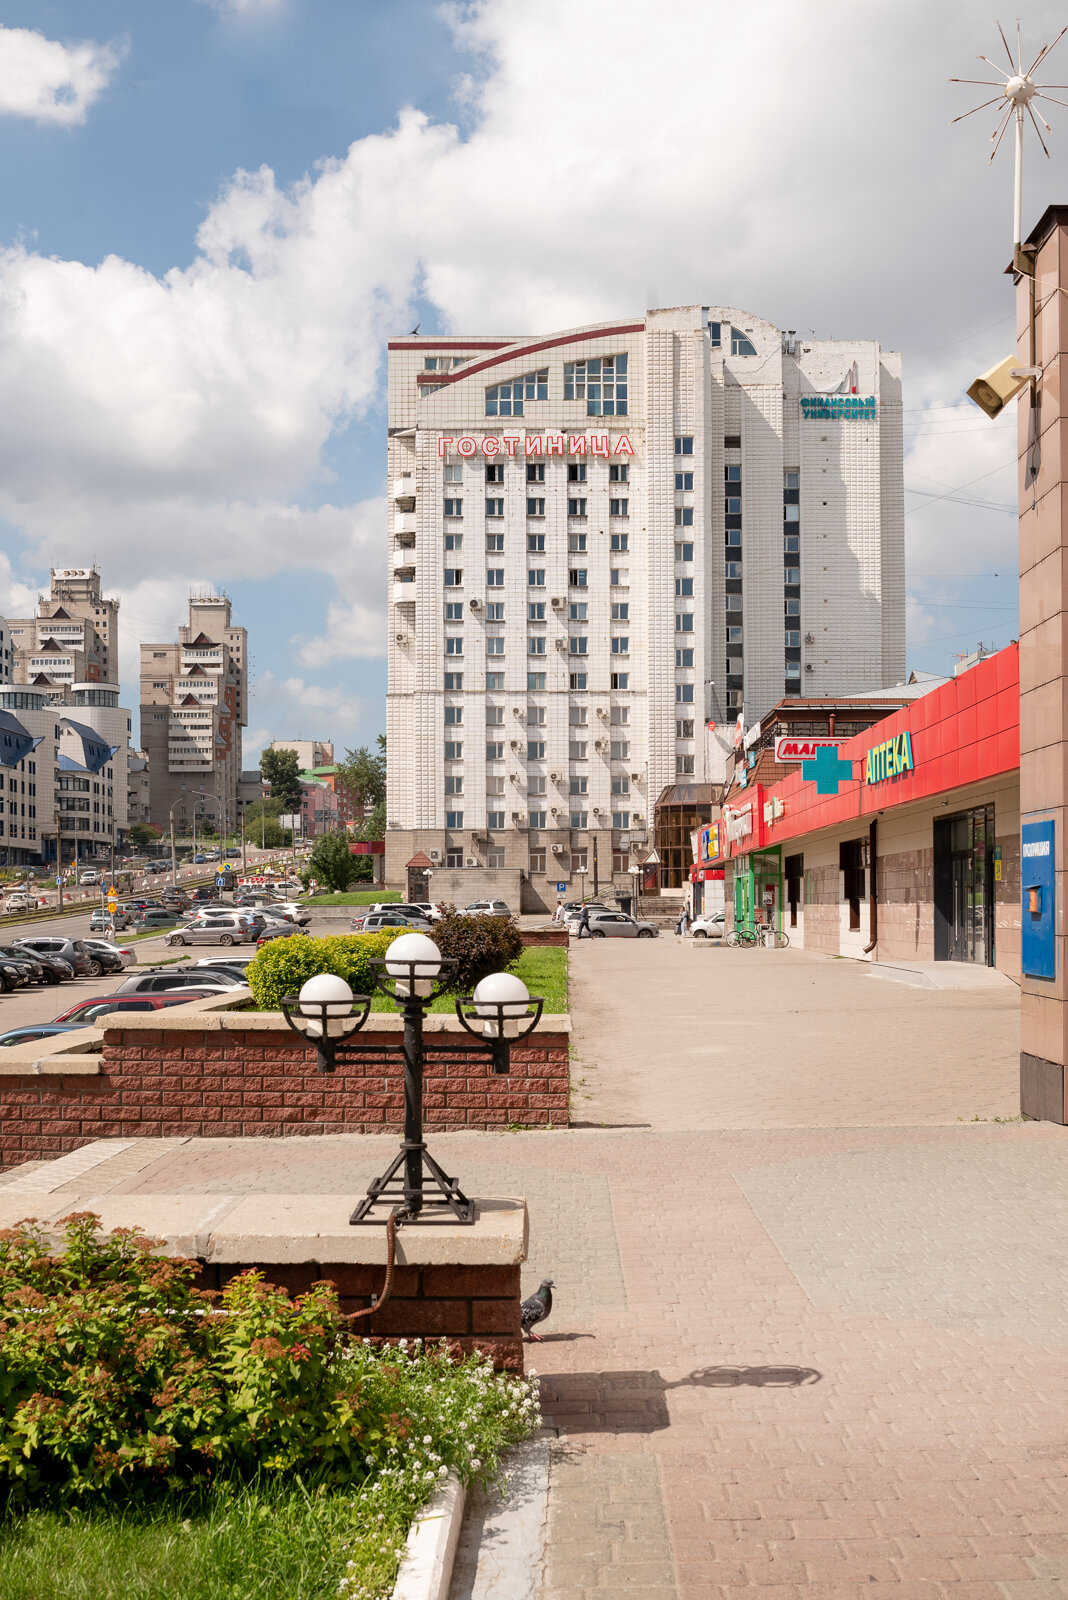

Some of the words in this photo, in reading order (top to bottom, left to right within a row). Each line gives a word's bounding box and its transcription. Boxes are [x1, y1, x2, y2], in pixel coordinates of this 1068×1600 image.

[800, 396, 876, 408] ФИНАНСОВЫЙ
[803, 409, 876, 419] УНИВЕРСИТЕТ
[438, 436, 635, 458] ГОСТИНИЦА
[782, 743, 840, 755] МАГ
[866, 731, 914, 785] АПТЕКА
